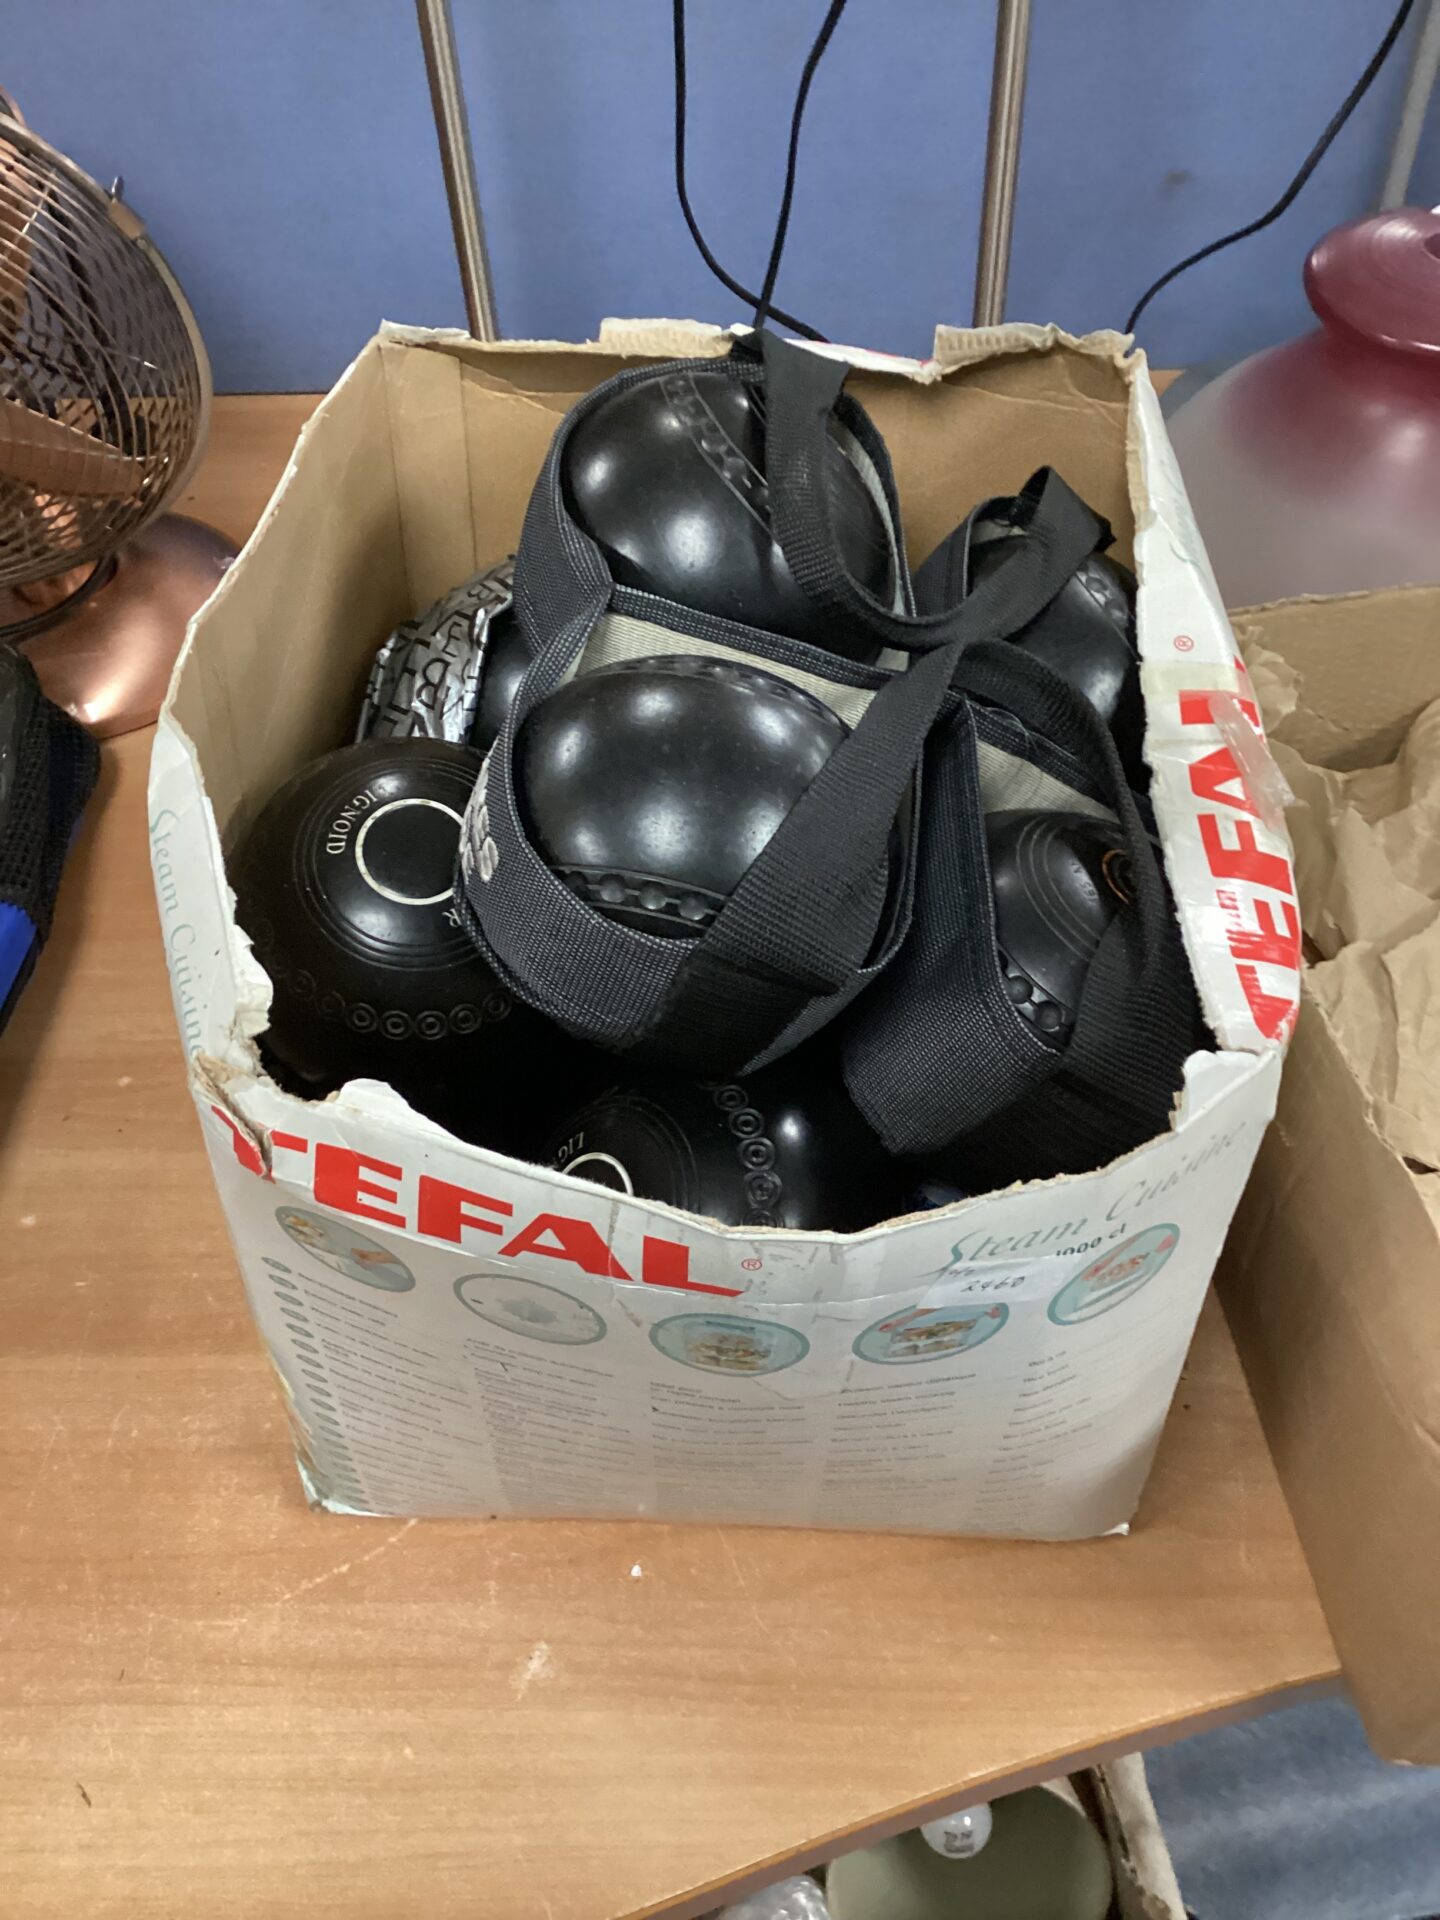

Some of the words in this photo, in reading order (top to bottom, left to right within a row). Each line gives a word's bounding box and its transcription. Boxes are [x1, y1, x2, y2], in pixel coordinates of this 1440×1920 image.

[149, 808, 181, 918] Steam
[211, 1105, 746, 1298] TEFAL
[919, 1216, 1090, 1277] Steam
